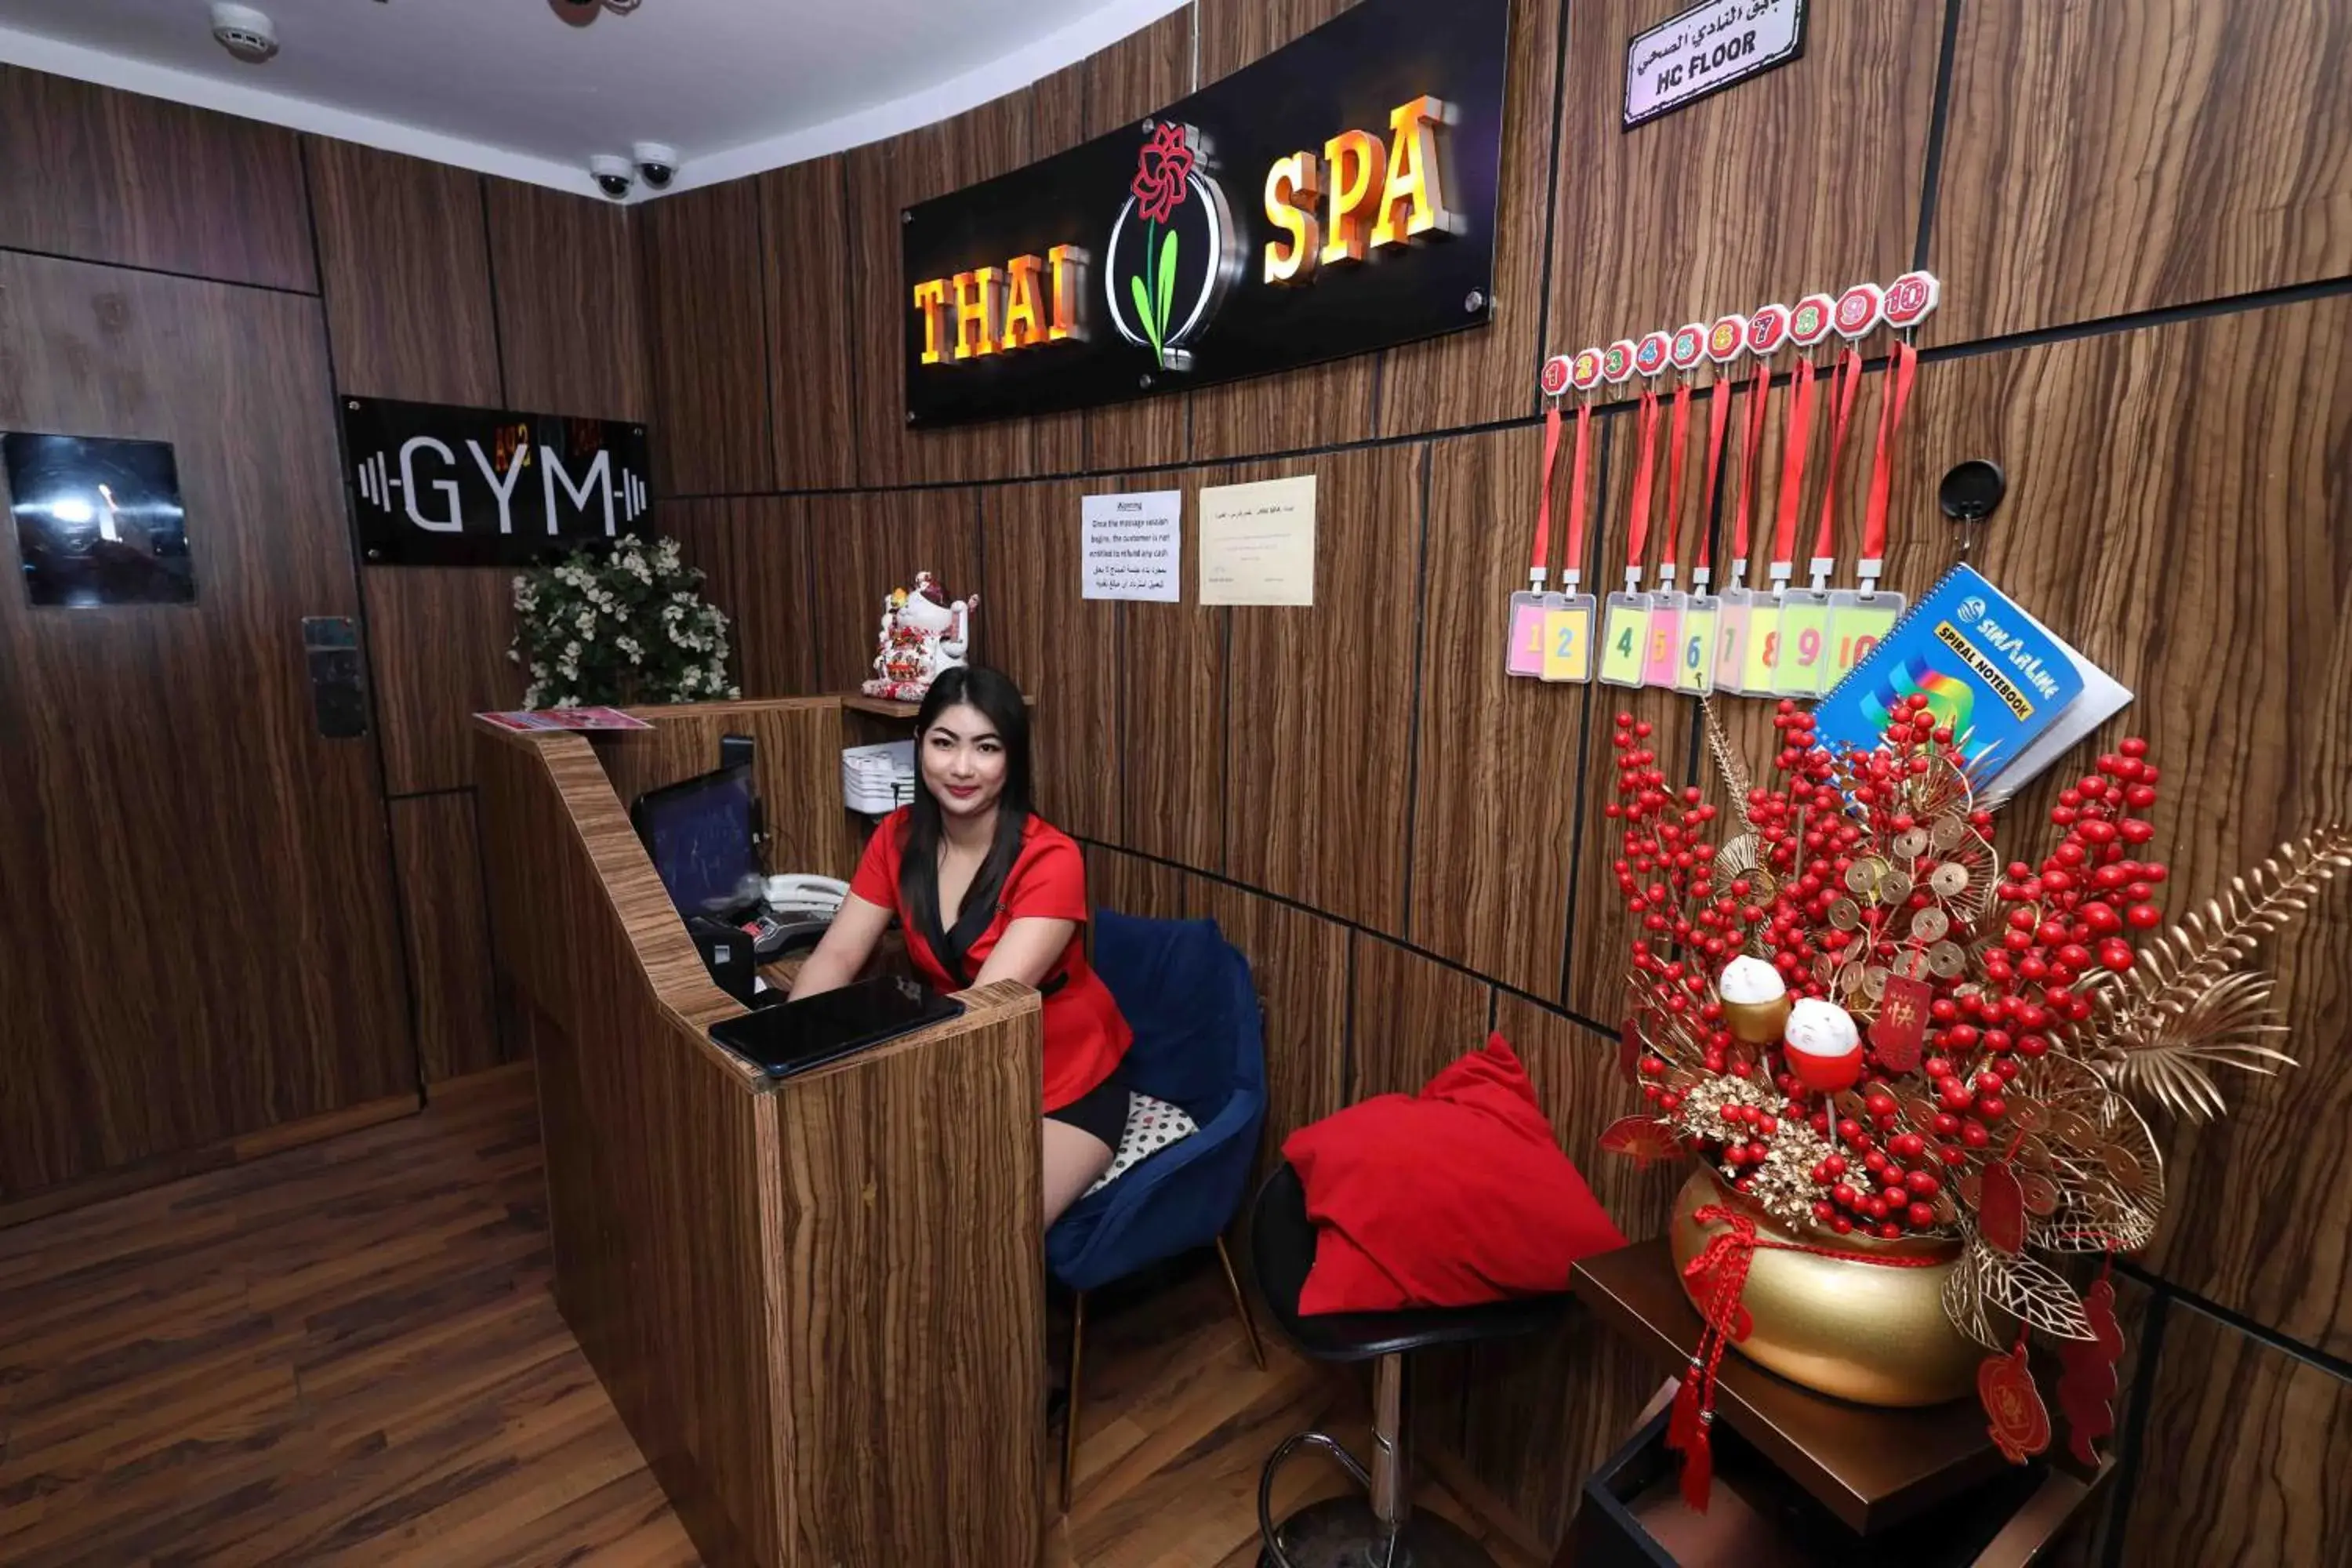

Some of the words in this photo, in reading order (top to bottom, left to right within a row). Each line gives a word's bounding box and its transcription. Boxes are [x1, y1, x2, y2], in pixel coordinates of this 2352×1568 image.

[1692, 5, 1743, 48] النادي
[1637, 32, 1689, 76] الصحي
[1656, 64, 1683, 96] HC
[1688, 30, 1757, 79] FLOOR
[914, 245, 1079, 364] THAI
[1264, 95, 1450, 285] SPA
[1842, 296, 1867, 325] 9
[1884, 281, 1926, 314] 10
[1752, 314, 1775, 343] 7
[1795, 307, 1819, 335] 8
[1639, 339, 1658, 363] 4
[1675, 334, 1694, 360] 5
[1712, 325, 1732, 350] 6
[1546, 363, 1559, 387] 1
[1576, 355, 1593, 379] 2
[1607, 350, 1623, 372] 3
[400, 435, 615, 536] GYM
[1120, 520, 1145, 529] massage
[1152, 533, 1158, 542] is
[1121, 549, 1140, 557] refund
[1526, 623, 1542, 653] 1
[1556, 626, 1576, 659] 2
[1616, 626, 1633, 659] 4
[1653, 629, 1668, 662] 5
[1686, 636, 1702, 668] 6
[1762, 630, 1781, 668] 8
[1798, 628, 1820, 666] 9
[1939, 627, 1976, 662] SPIRAL
[1975, 661, 2030, 717] NOTEBOOK
